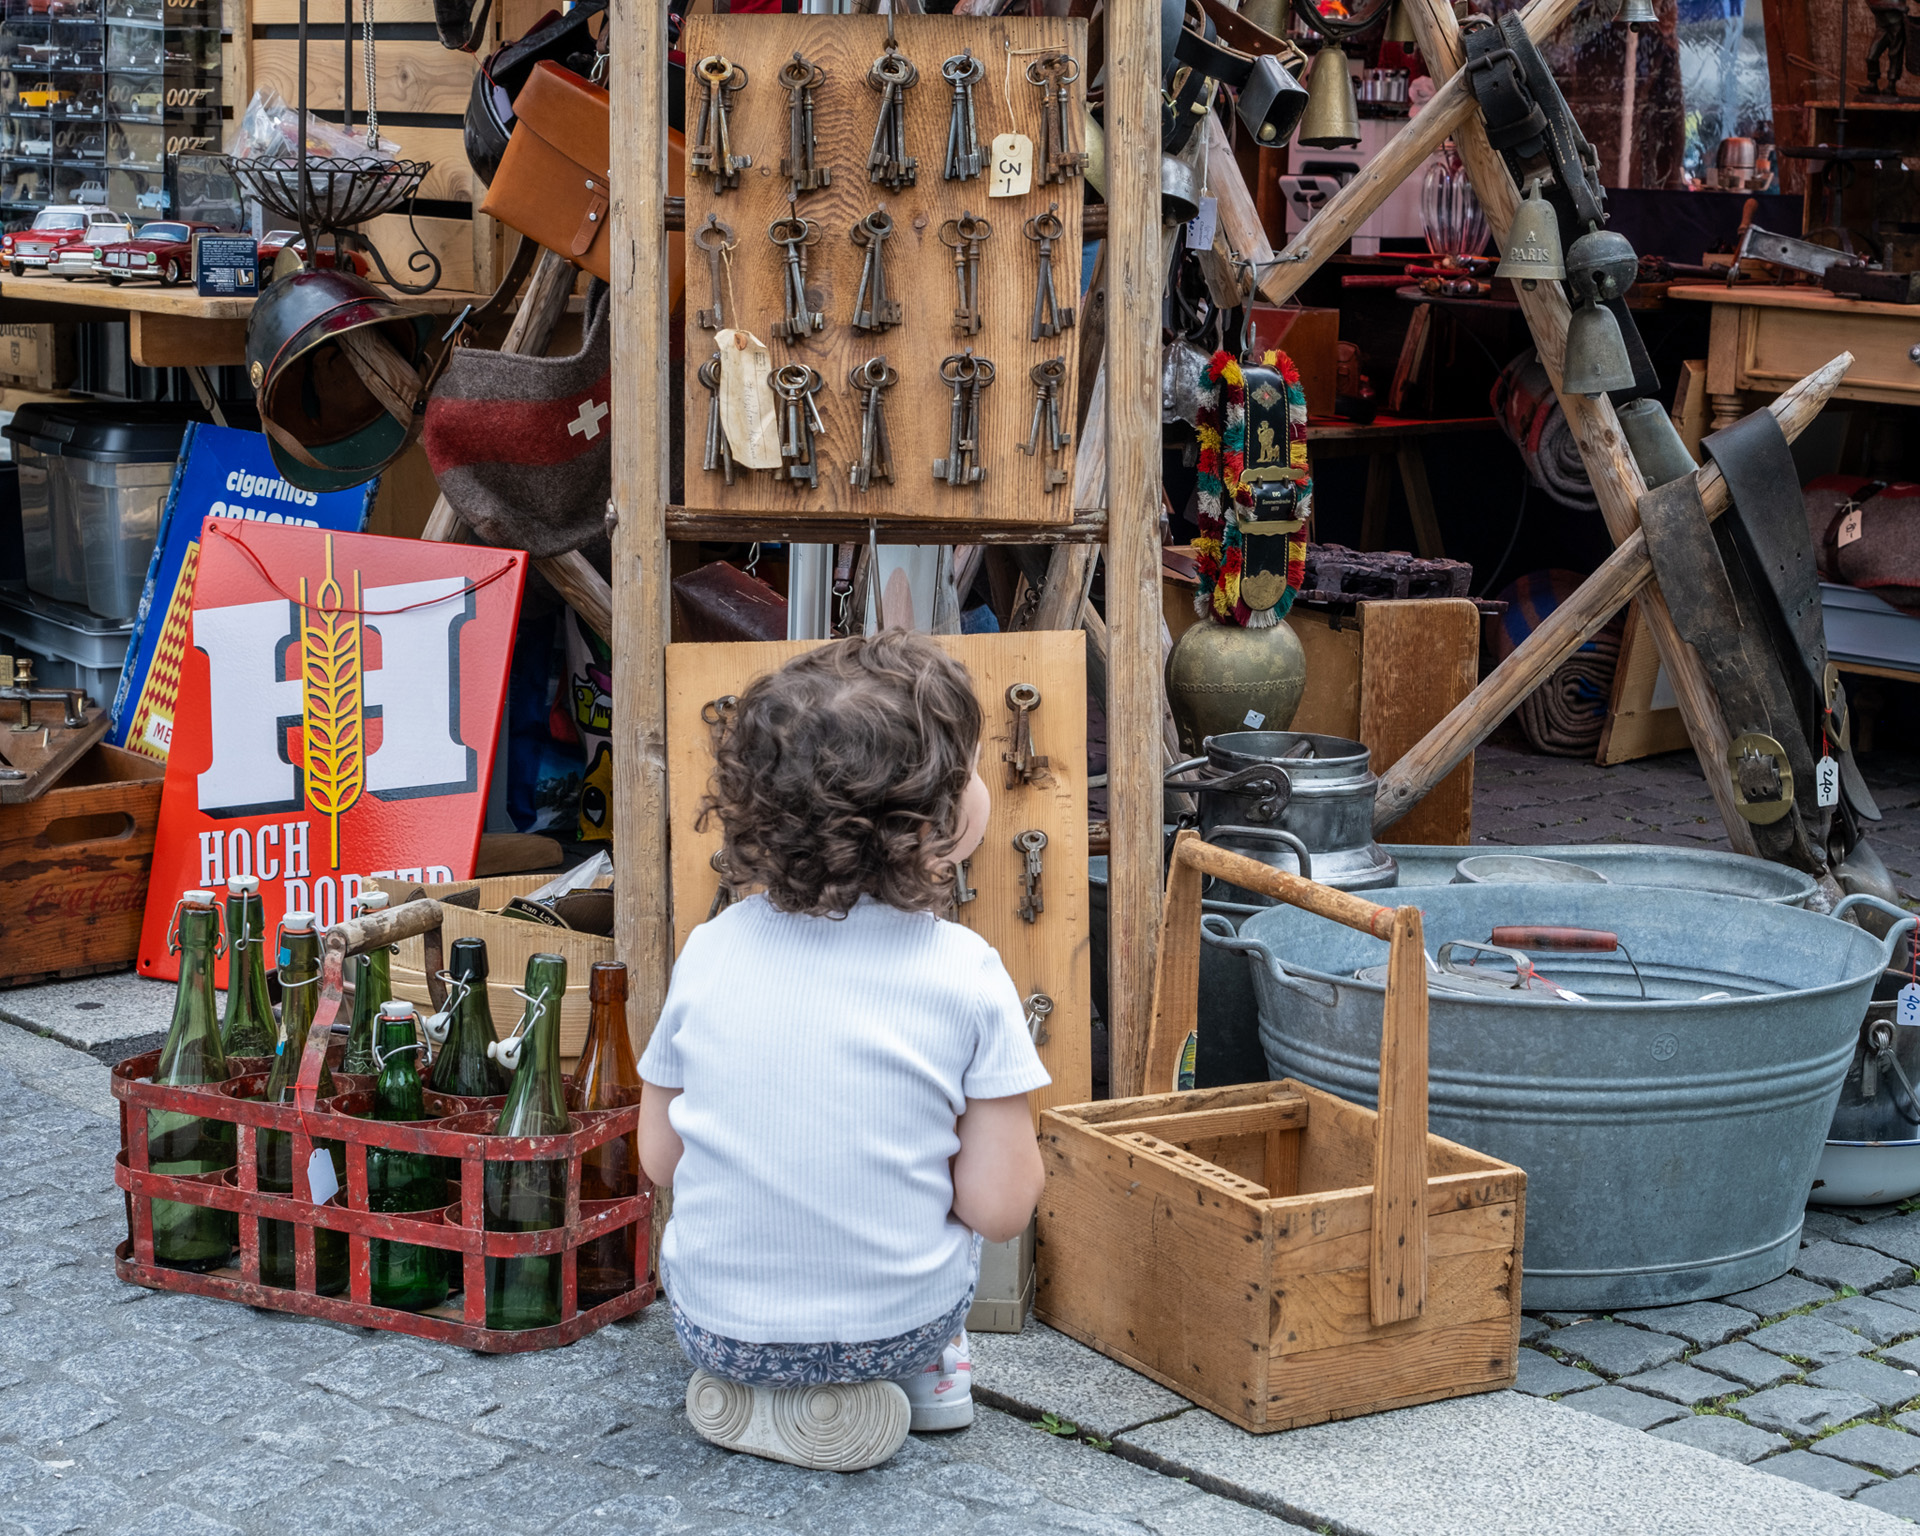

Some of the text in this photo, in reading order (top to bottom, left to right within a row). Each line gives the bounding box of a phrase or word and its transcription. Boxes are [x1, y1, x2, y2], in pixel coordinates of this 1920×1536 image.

[167, 88, 205, 107] 007
[999, 159, 1022, 193] 3.-
[1525, 230, 1537, 243] A
[1509, 247, 1550, 262] PARIS
[225, 468, 318, 507] cigarillos
[199, 821, 311, 887] HOCH
[521, 903, 538, 915] San
[1654, 1039, 1674, 1055] 56
